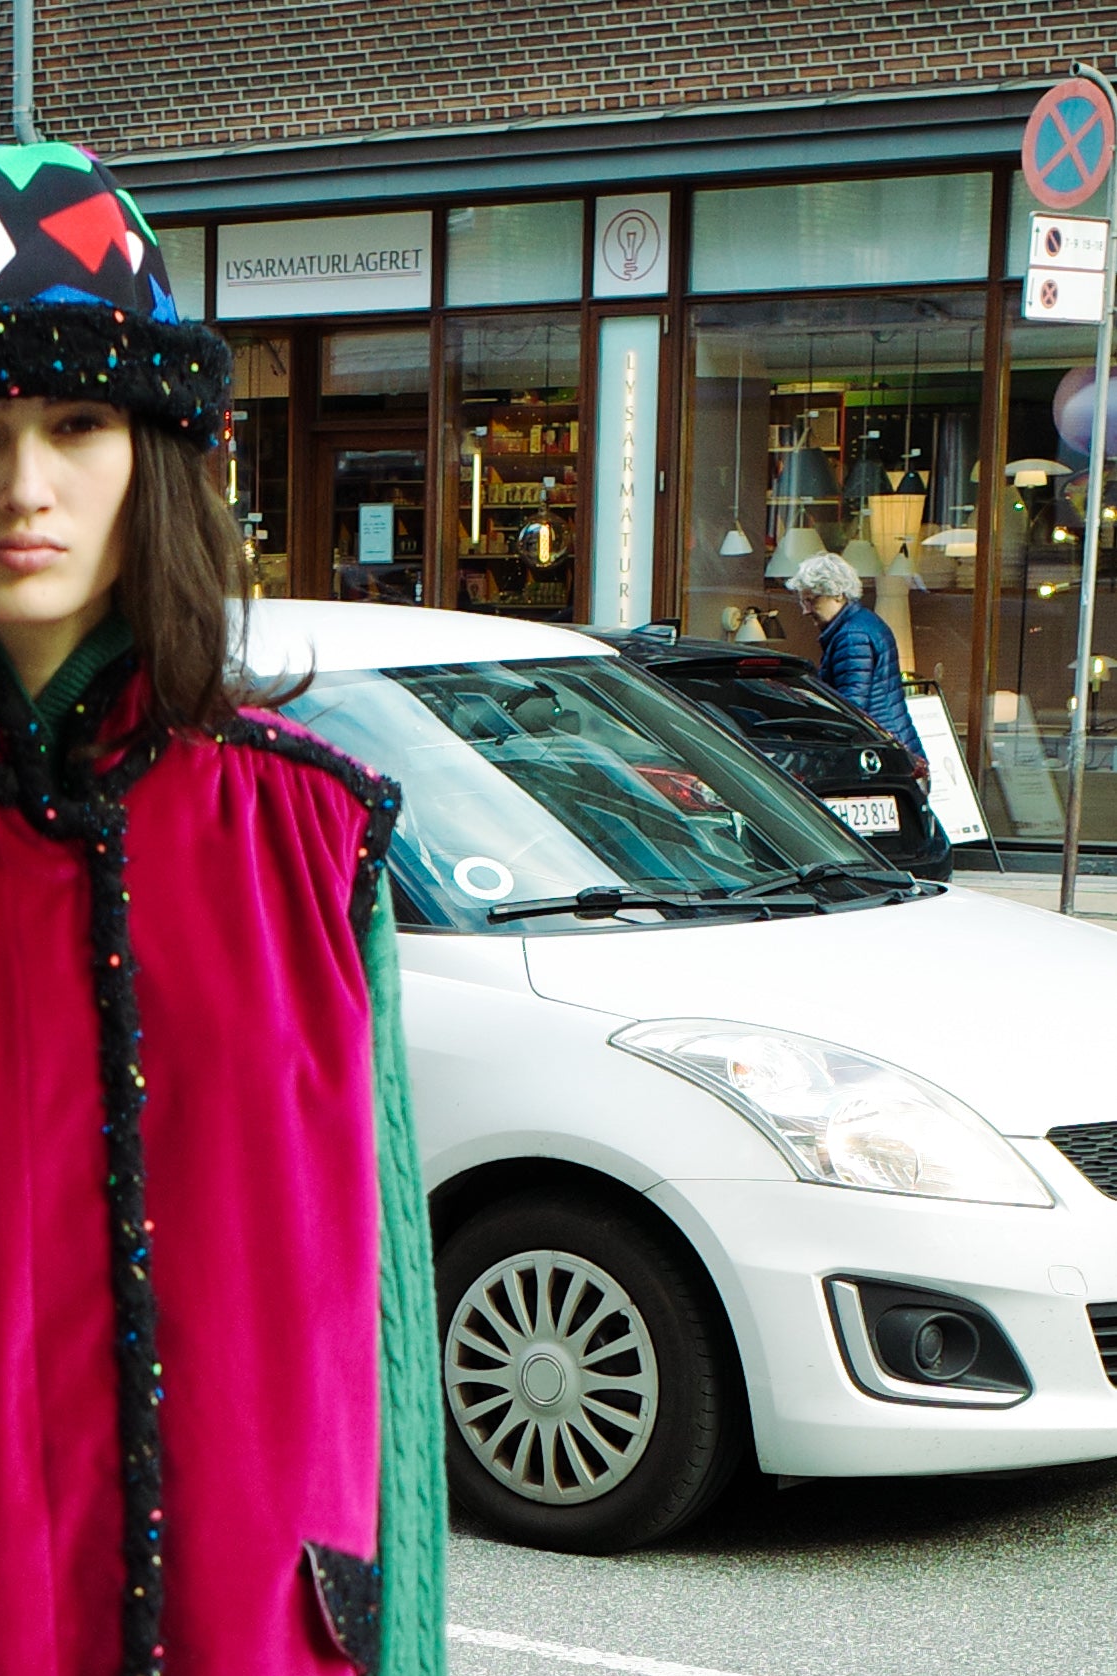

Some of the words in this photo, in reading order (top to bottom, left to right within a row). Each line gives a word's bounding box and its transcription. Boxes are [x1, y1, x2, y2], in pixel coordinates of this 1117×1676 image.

[226, 249, 423, 279] LYSARMATURLAGERET
[619, 354, 635, 624] LYSARMATURL
[852, 804, 868, 825] 23
[871, 803, 896, 825] 814
